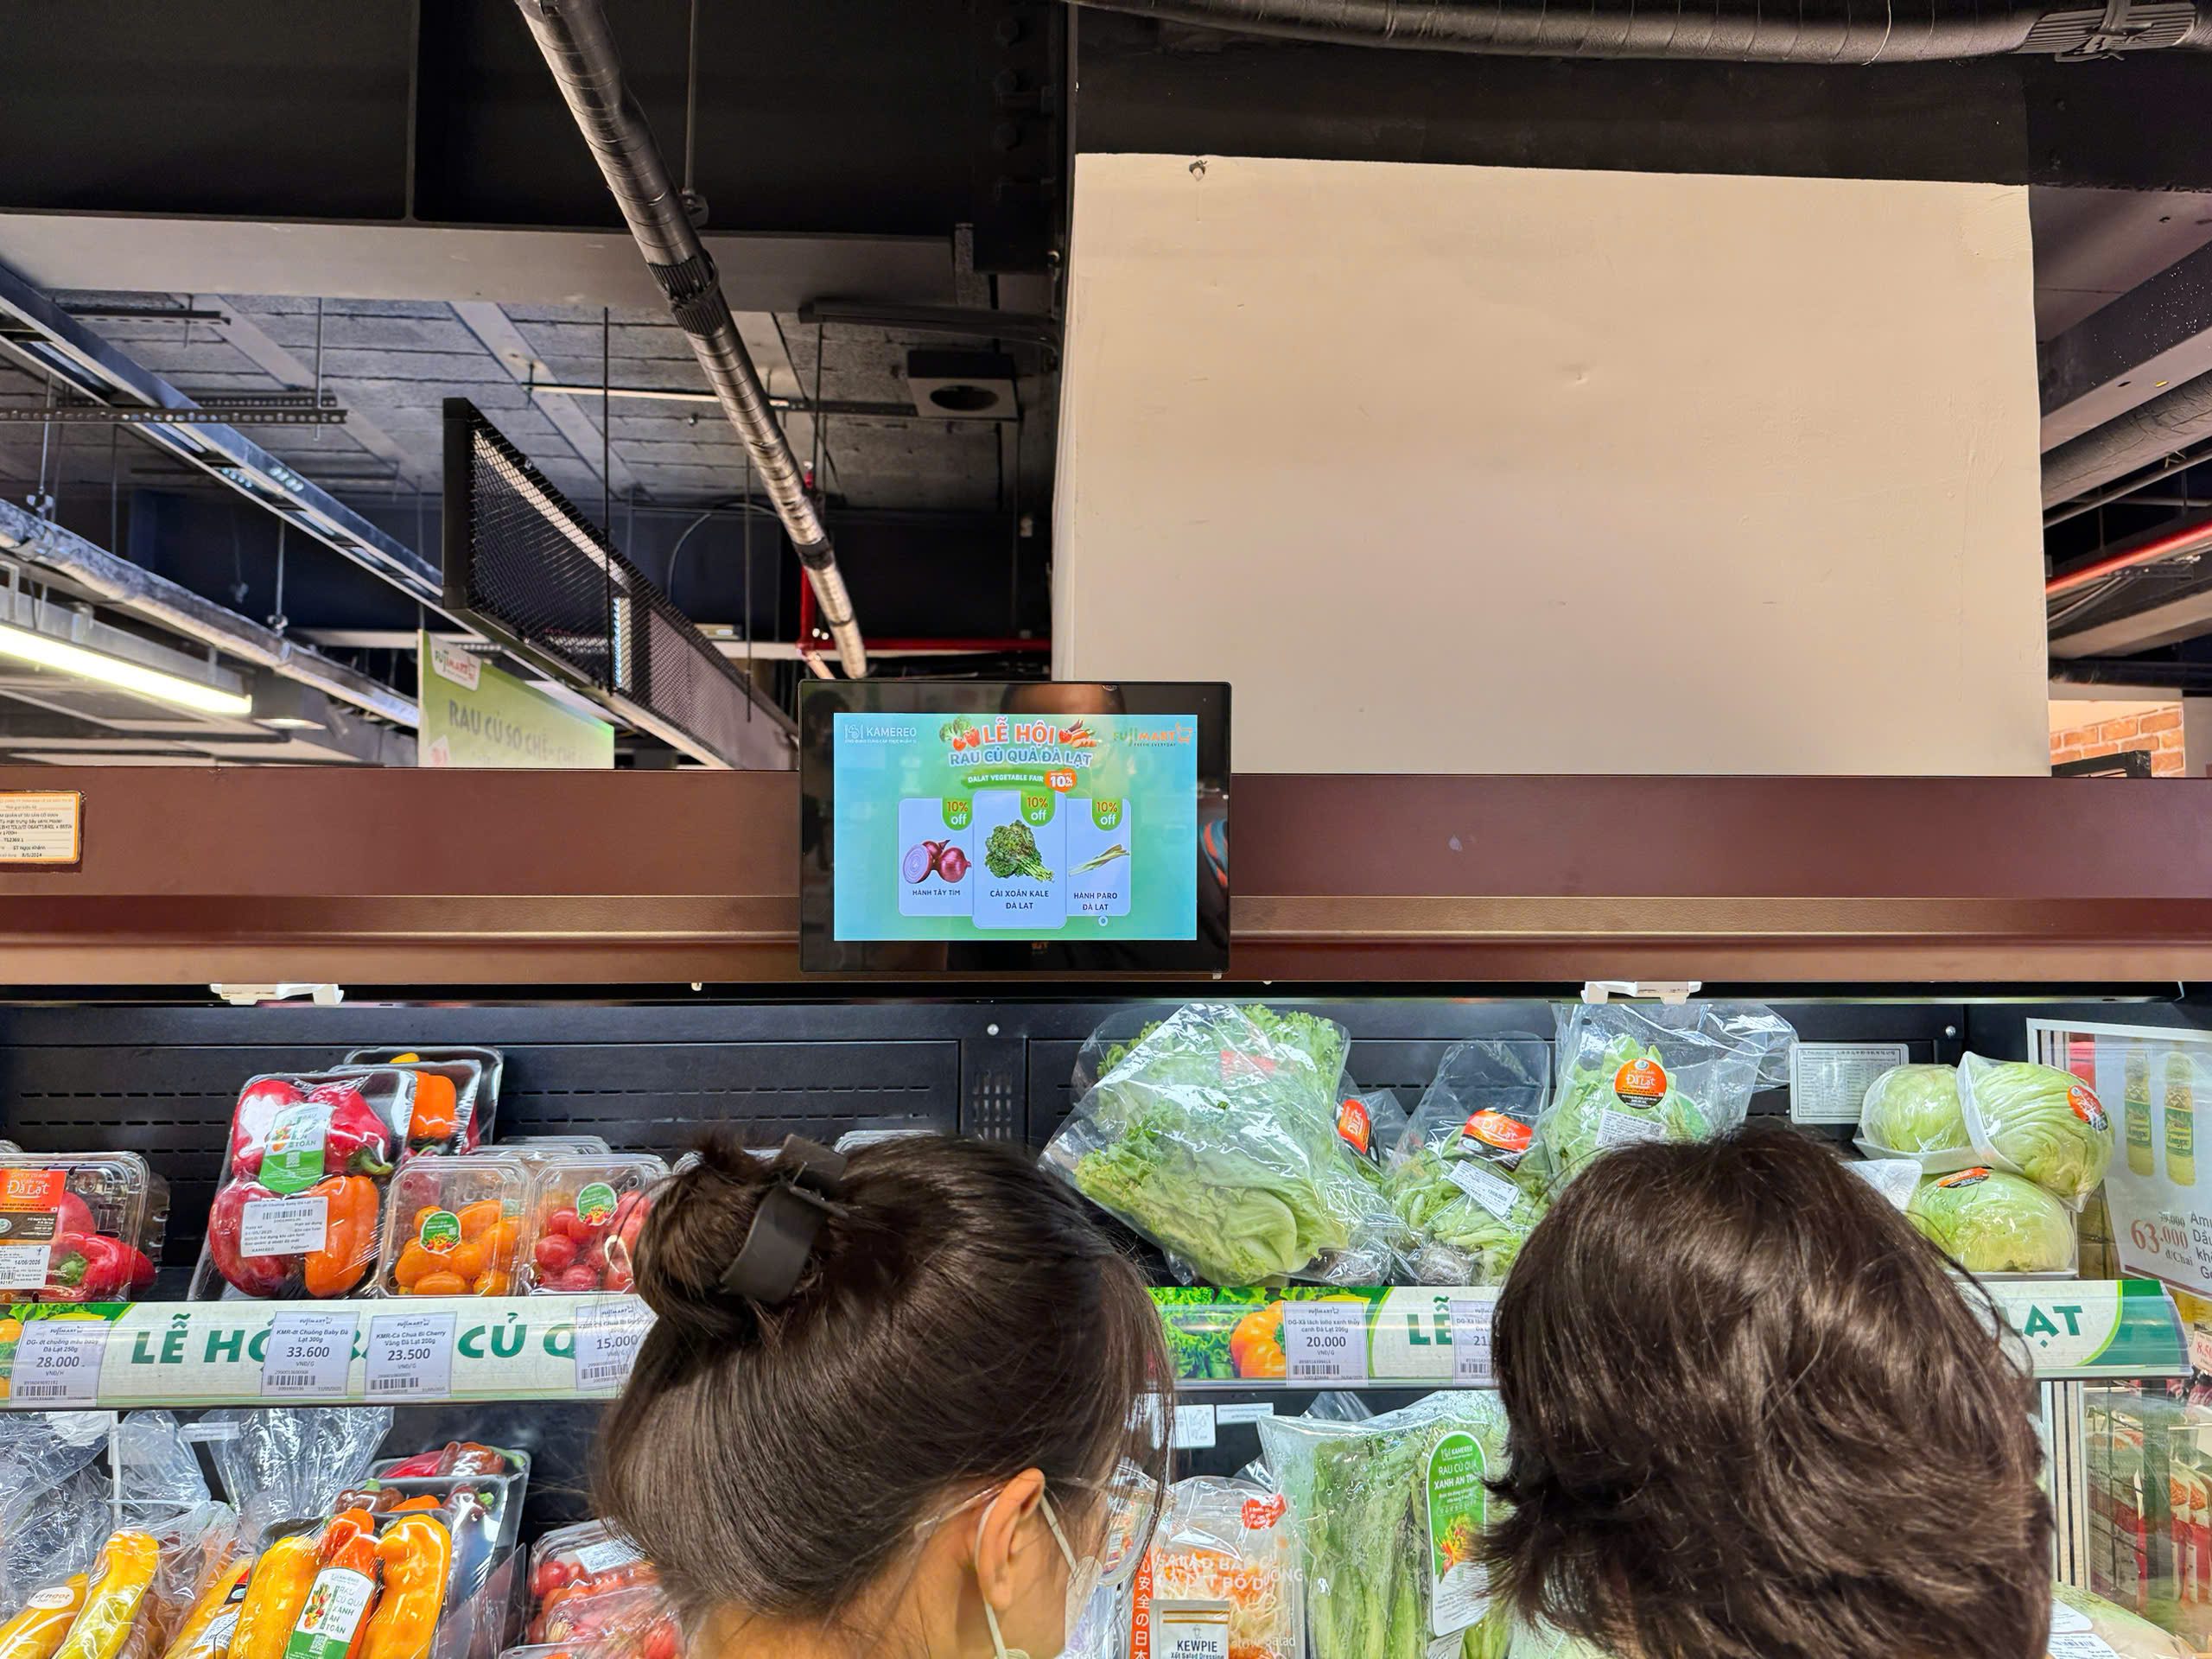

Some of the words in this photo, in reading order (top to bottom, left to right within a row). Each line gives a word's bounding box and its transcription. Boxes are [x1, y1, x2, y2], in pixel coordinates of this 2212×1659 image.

[866, 727, 917, 737] KAMEREO
[982, 716, 1008, 744] LỄ
[1015, 720, 1056, 747] HỘI
[950, 751, 980, 766] RAU
[984, 747, 1003, 763] CỦ
[1007, 747, 1037, 763] QUẢ
[1041, 748, 1062, 764] ĐÀ
[1065, 752, 1092, 767] LẠT
[947, 801, 968, 812] 10%
[1027, 797, 1048, 808] 10%
[1096, 801, 1118, 812] 10%
[951, 814, 967, 825] off
[1031, 810, 1046, 821] off
[1100, 815, 1116, 825] off
[1029, 889, 1049, 898] KALE
[1073, 891, 1096, 899] HÀNH
[1006, 900, 1018, 910] ĐÀ
[2130, 1219, 2189, 1255] 63.000
[1406, 1295, 1452, 1345] LỄ
[130, 1313, 192, 1364] LỄ
[457, 1313, 528, 1359] CỦ
[596, 1334, 639, 1350] 15.000
[1306, 1336, 1346, 1348] 20.000
[286, 1346, 330, 1357] 33.600
[387, 1347, 431, 1362] 23.500
[36, 1356, 80, 1368] 28.000
[1438, 1465, 1452, 1476] RAU
[1433, 1478, 1454, 1491] XANH
[1454, 1476, 1465, 1486] AN
[332, 1605, 355, 1617] XANH
[1176, 1640, 1217, 1652] KEWPIE
